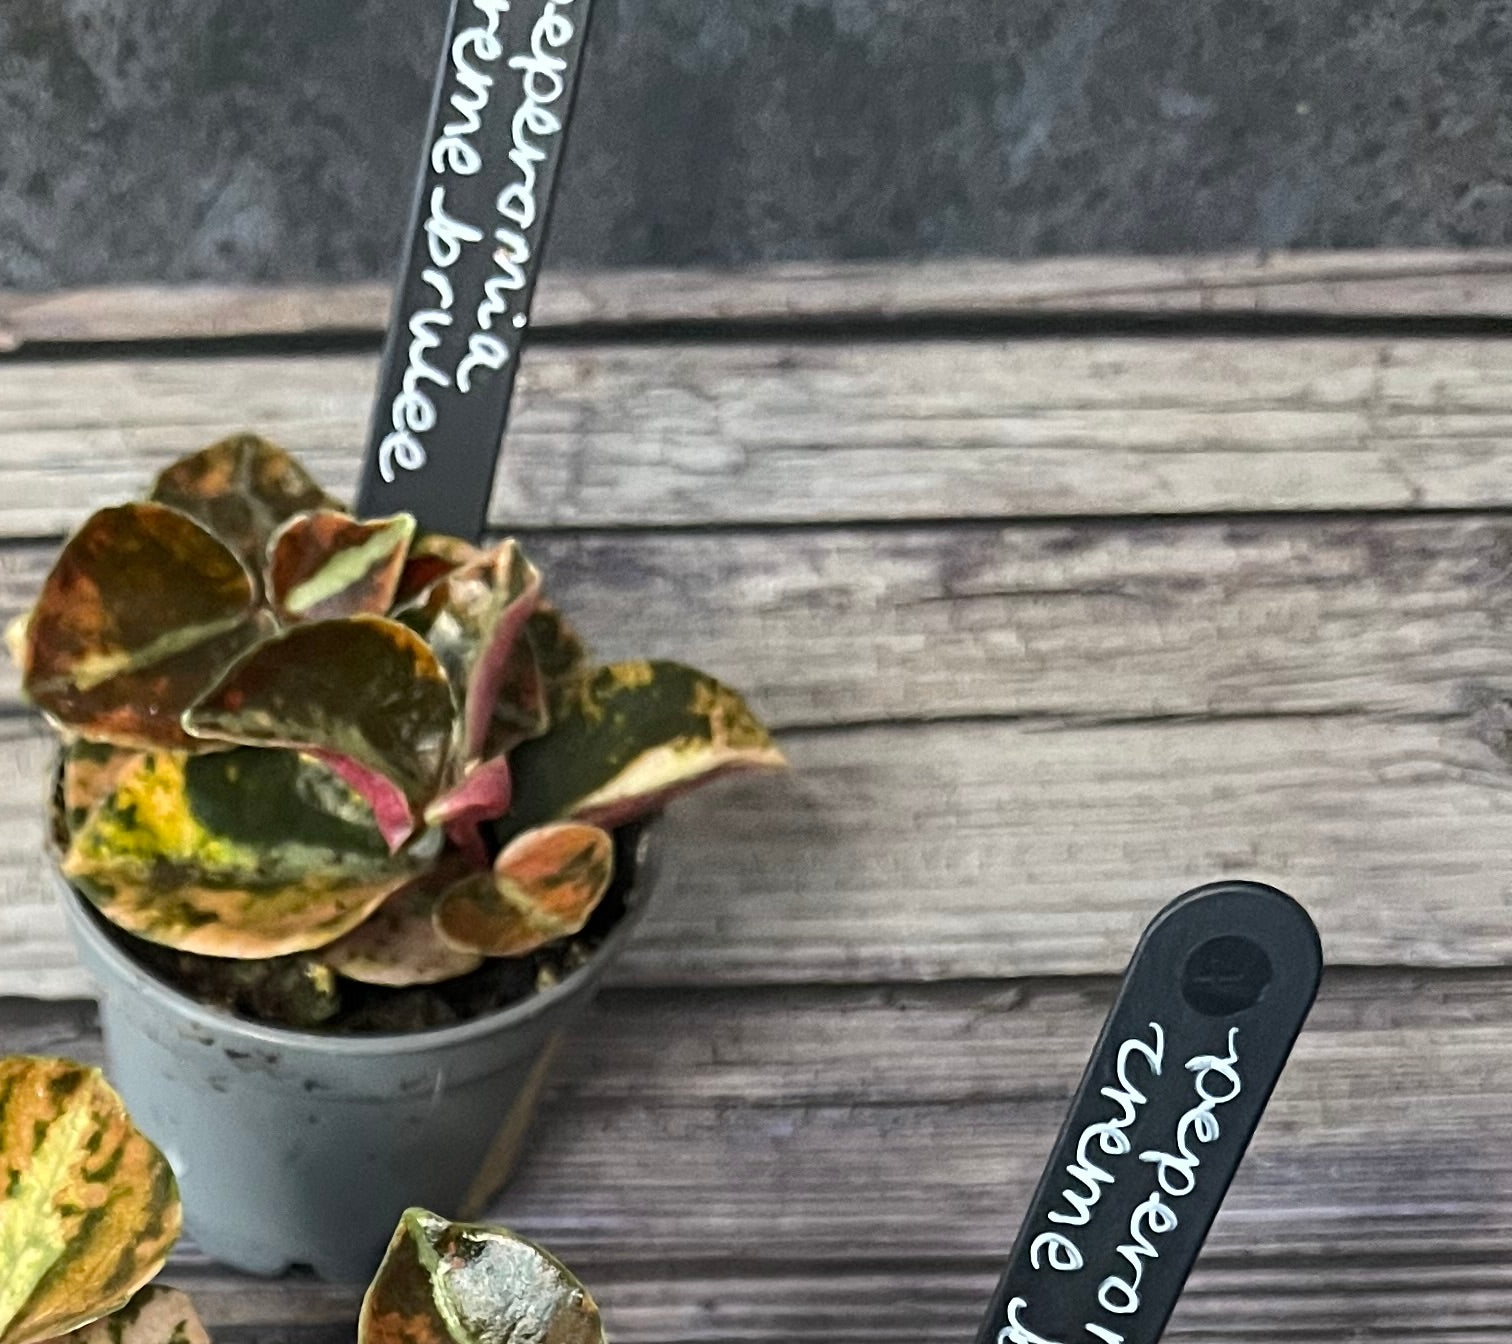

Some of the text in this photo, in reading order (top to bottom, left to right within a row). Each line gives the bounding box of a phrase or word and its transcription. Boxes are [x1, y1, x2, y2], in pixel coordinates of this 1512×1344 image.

[431, 0, 510, 175] reme
[455, 0, 574, 393] eperomia
[1030, 1022, 1165, 1272] creme
